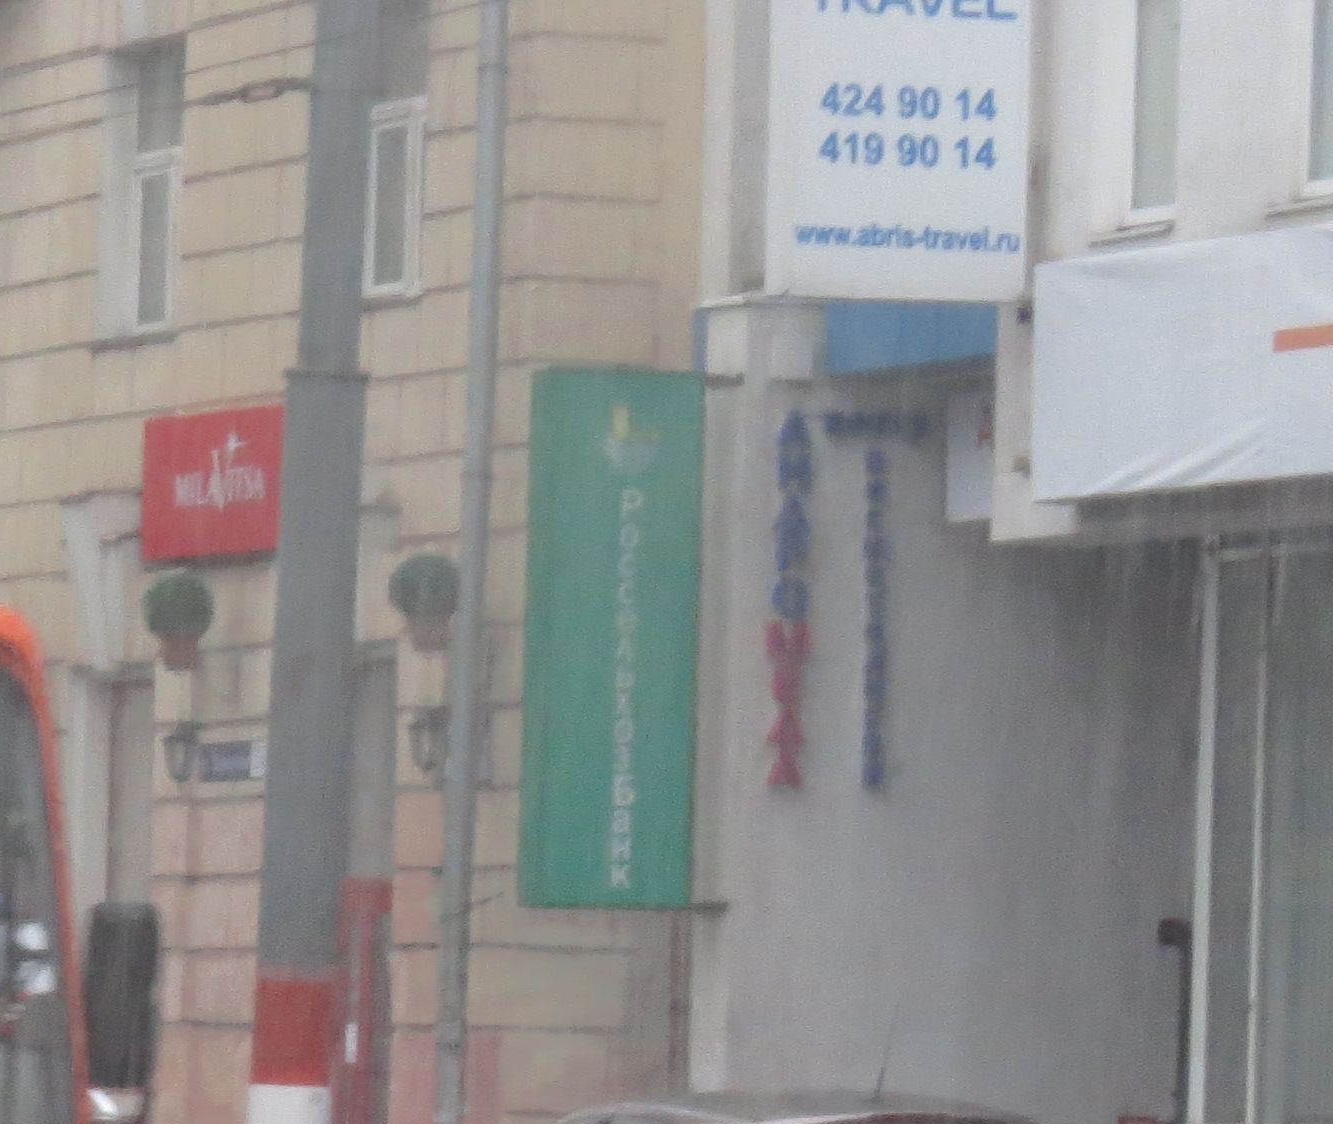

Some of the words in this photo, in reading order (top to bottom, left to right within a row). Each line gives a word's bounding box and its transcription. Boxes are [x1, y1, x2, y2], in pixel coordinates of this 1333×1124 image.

[820, 83, 884, 117] 424
[898, 85, 940, 119] 90
[955, 87, 998, 122] 14
[819, 131, 885, 166] 419
[898, 133, 940, 168] 90
[954, 136, 997, 170] 14
[795, 222, 1021, 254] www.abris-travel.ru
